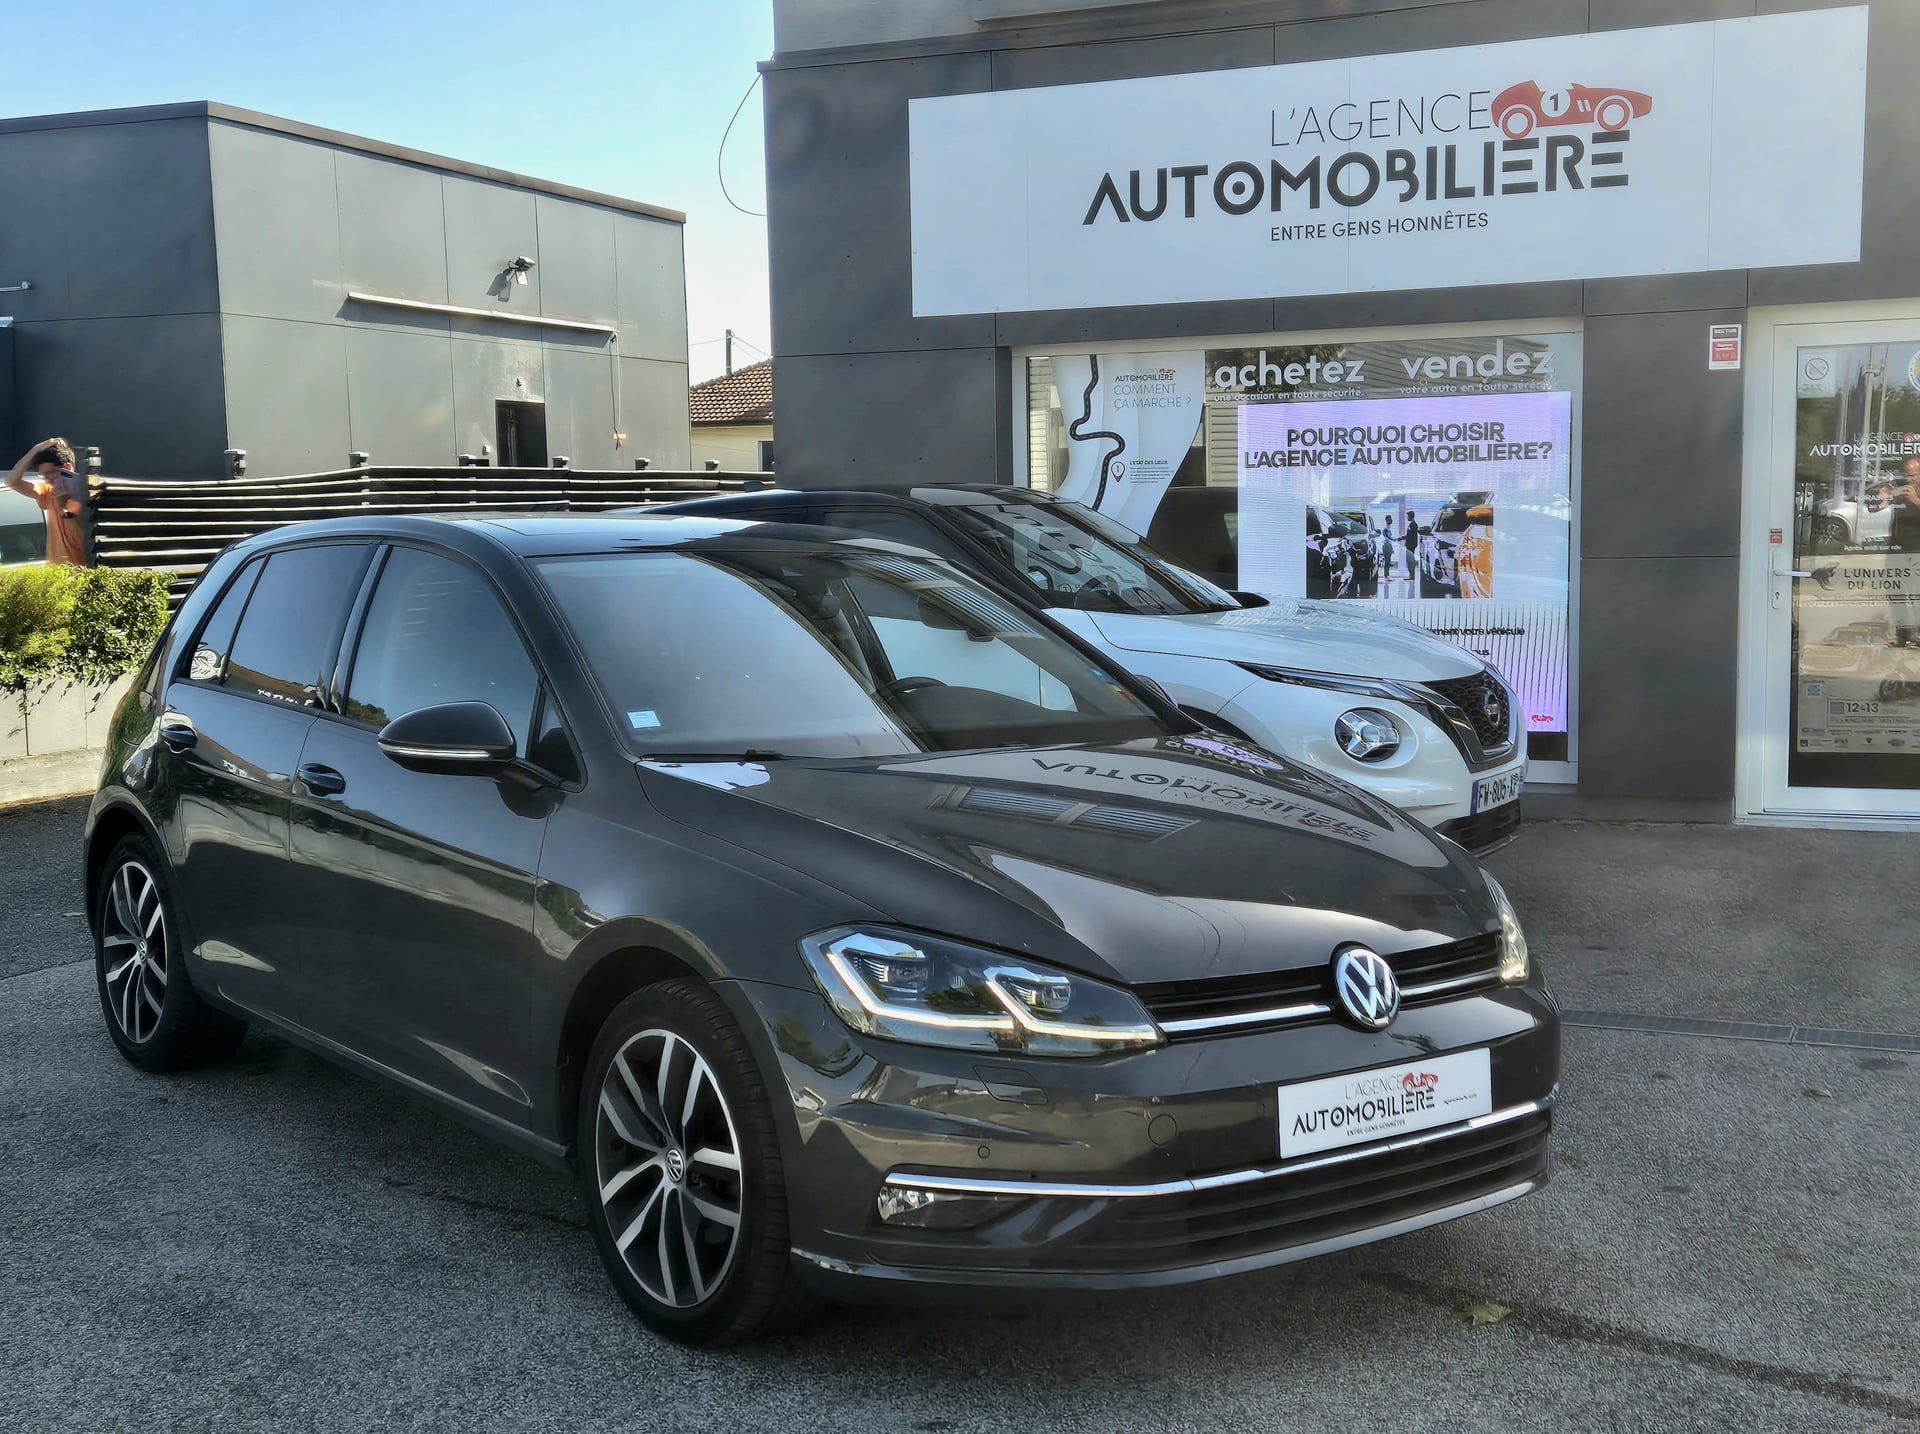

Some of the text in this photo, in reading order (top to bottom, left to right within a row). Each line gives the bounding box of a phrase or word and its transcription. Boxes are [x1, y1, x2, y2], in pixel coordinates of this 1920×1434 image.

[1271, 91, 1490, 147] L'AGENCE
[1271, 210, 1489, 241] ENTRE GENS HONNÊTES
[1214, 338, 1555, 388] achetez vendez
[1113, 383, 1177, 396] COMMENT
[1214, 393, 1232, 402] une
[1234, 391, 1275, 401] occasion
[1278, 392, 1290, 400] en
[1293, 389, 1319, 399] toute
[1400, 385, 1428, 394] votre
[1432, 383, 1457, 393] auto
[1461, 384, 1474, 392] en
[1479, 381, 1508, 391] toute
[1113, 398, 1129, 411] ÇA
[1132, 397, 1182, 408] MARCHE
[1287, 421, 1505, 448] POURQUOI CHOISIR
[1244, 448, 1347, 469] L'AGENCE
[1848, 580, 1901, 590] DU LION
[1344, 1073, 1402, 1100] L'AGENCE
